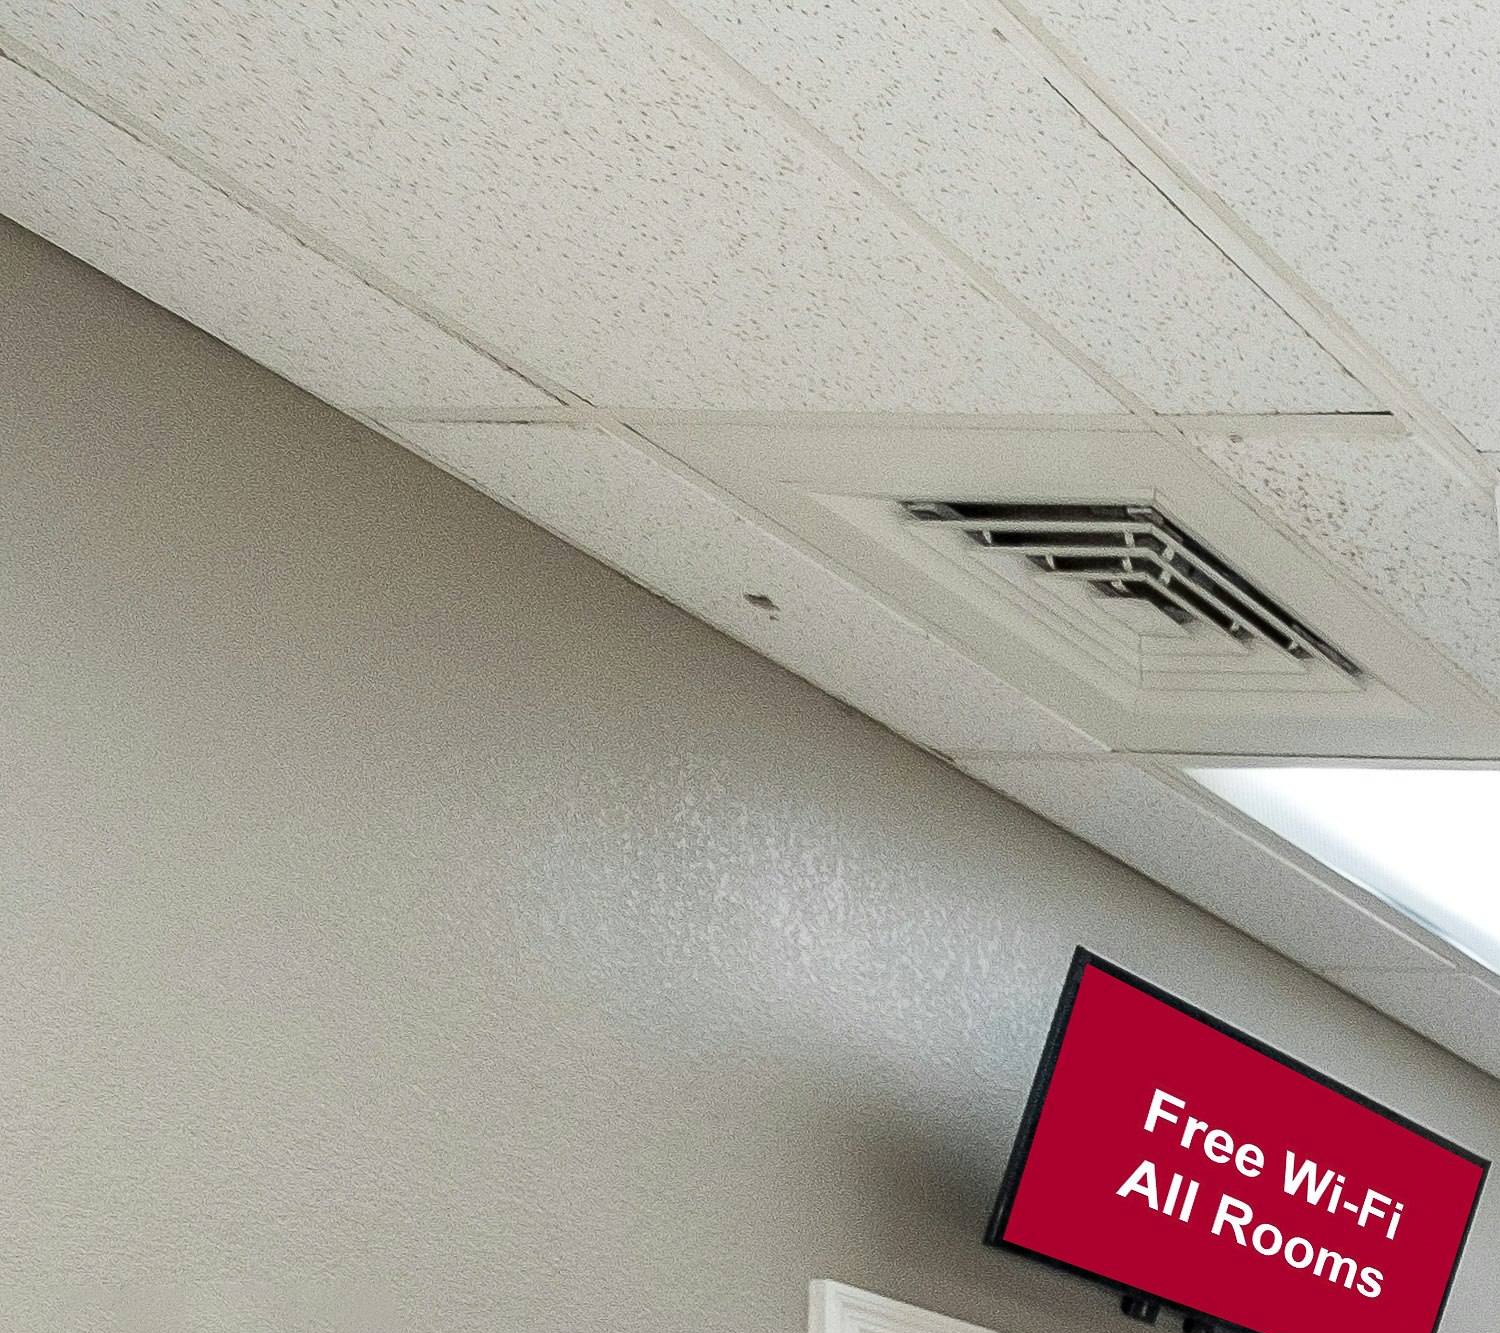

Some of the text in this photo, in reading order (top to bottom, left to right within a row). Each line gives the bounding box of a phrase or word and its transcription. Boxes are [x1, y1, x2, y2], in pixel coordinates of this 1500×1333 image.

[1116, 1160, 1384, 1299] All Rooms
[1144, 1089, 1405, 1241] Free Wi-Fi
